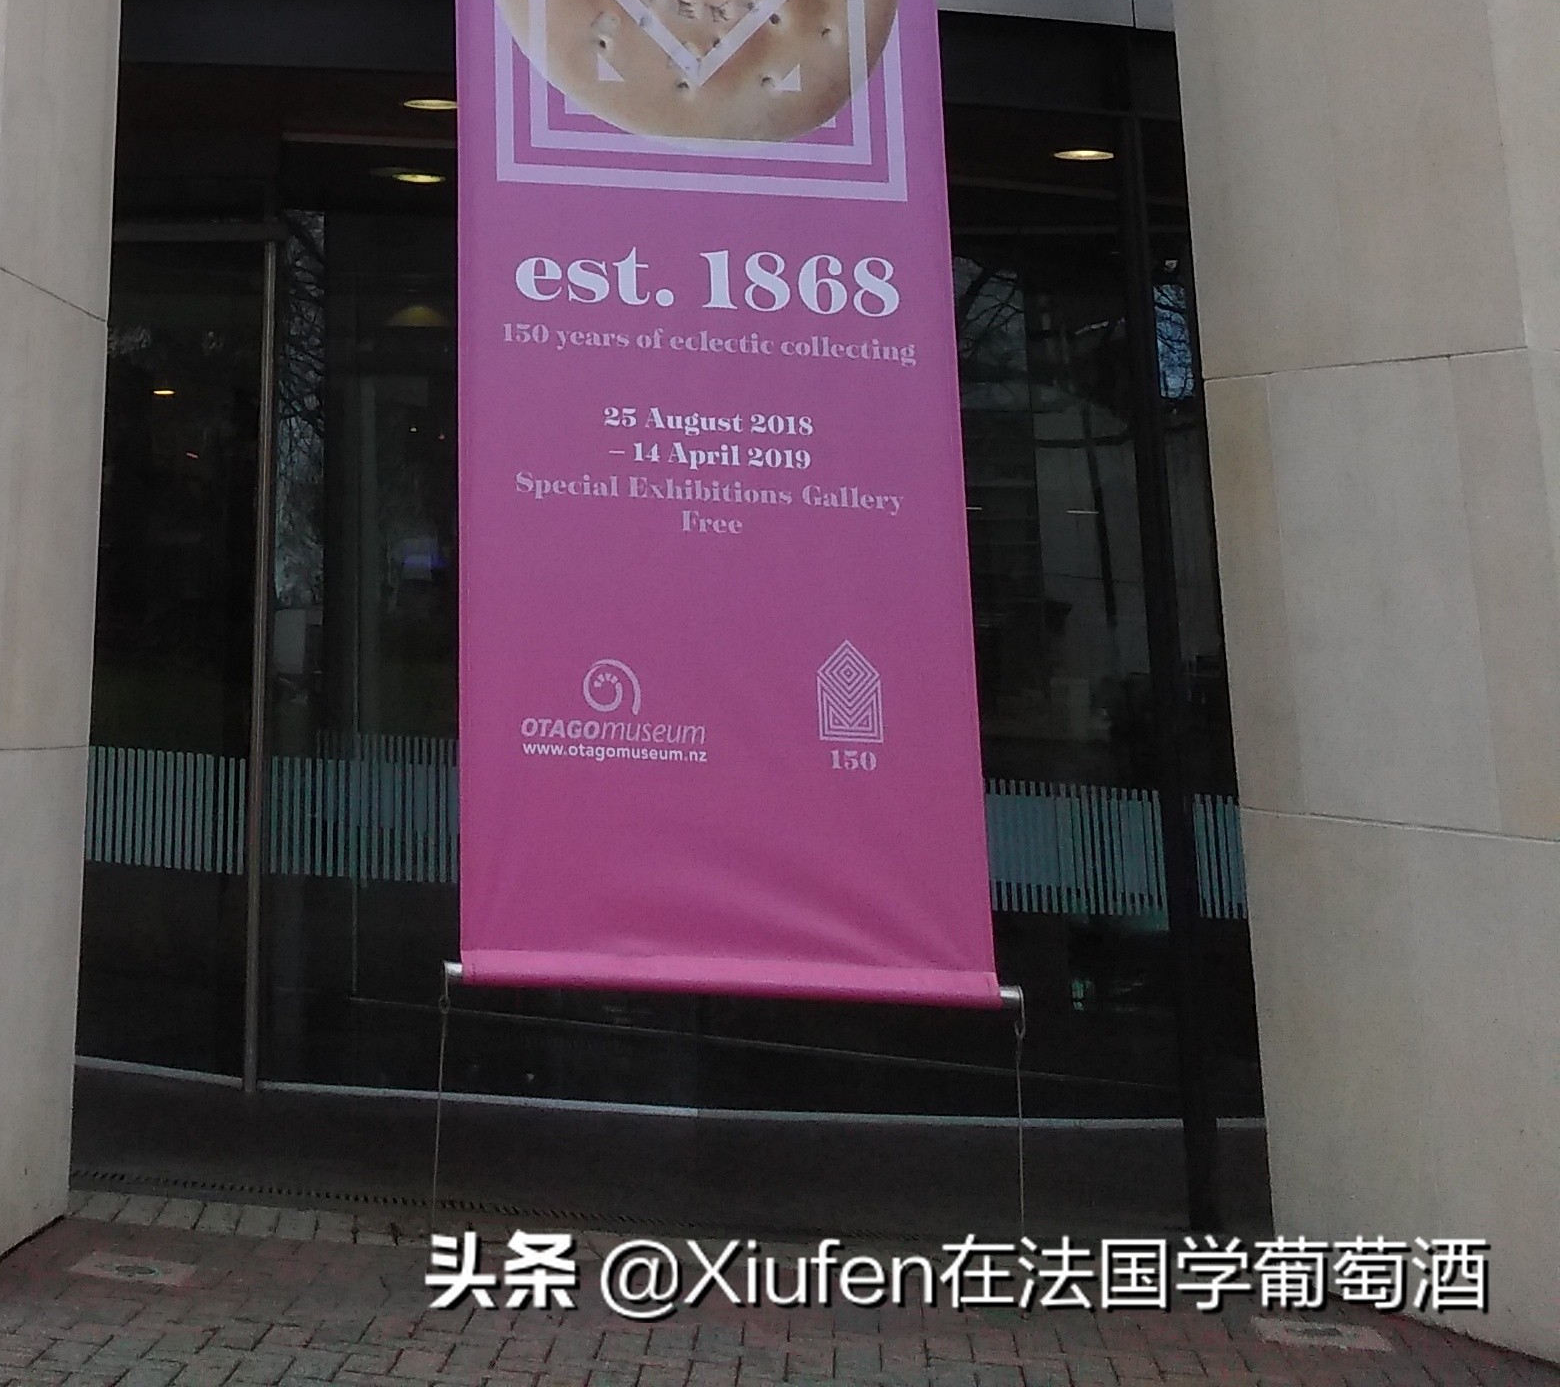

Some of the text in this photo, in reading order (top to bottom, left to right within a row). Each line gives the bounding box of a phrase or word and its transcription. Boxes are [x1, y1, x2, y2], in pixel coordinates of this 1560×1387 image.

[515, 246, 901, 319] est. 1868
[502, 322, 917, 367] 150 years of eclectic collecting
[602, 405, 814, 438] 25 August 2018
[632, 441, 661, 464] 14
[667, 441, 741, 470] April
[746, 446, 812, 470] 2019
[514, 470, 904, 516] Special Exhibitions Gallery
[680, 509, 744, 535] Free
[522, 743, 708, 762] www.otagomuseum.nz
[829, 748, 878, 772] 150
